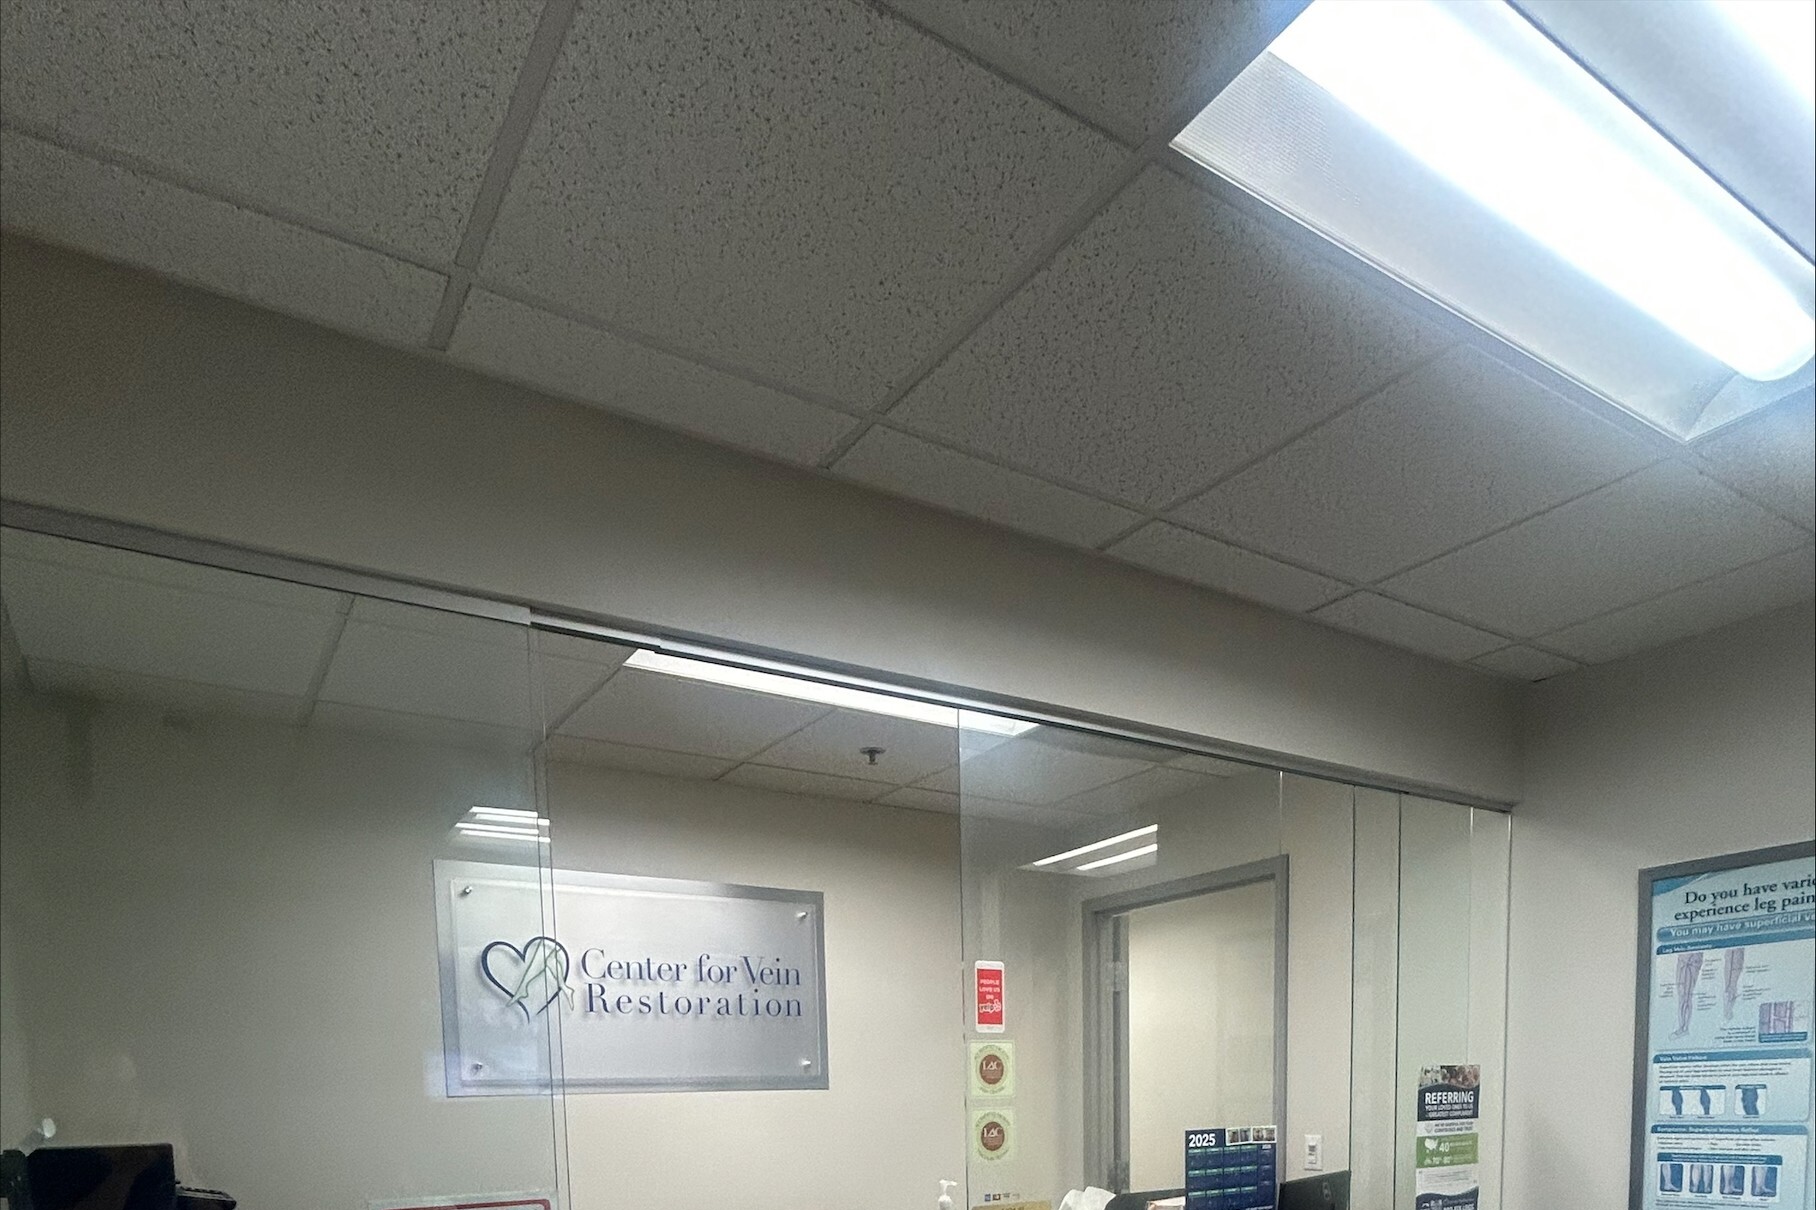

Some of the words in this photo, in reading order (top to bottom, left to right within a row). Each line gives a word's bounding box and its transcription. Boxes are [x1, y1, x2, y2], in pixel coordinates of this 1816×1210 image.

[1674, 904, 1750, 922] experience
[1755, 897, 1776, 912] leg
[1781, 891, 1815, 910] pain
[1685, 891, 1707, 904] Do
[1711, 889, 1738, 906] you
[1743, 883, 1778, 896] have
[1670, 927, 1690, 937] You
[1692, 926, 1713, 938] may
[1716, 922, 1742, 932] have
[1744, 914, 1801, 928] superficial
[581, 948, 688, 982] Center
[698, 953, 738, 983] for
[740, 955, 801, 986] Vein
[584, 982, 803, 1017] Restoration
[1425, 1091, 1474, 1105] REFERRING
[1188, 1134, 1216, 1147] 2025
